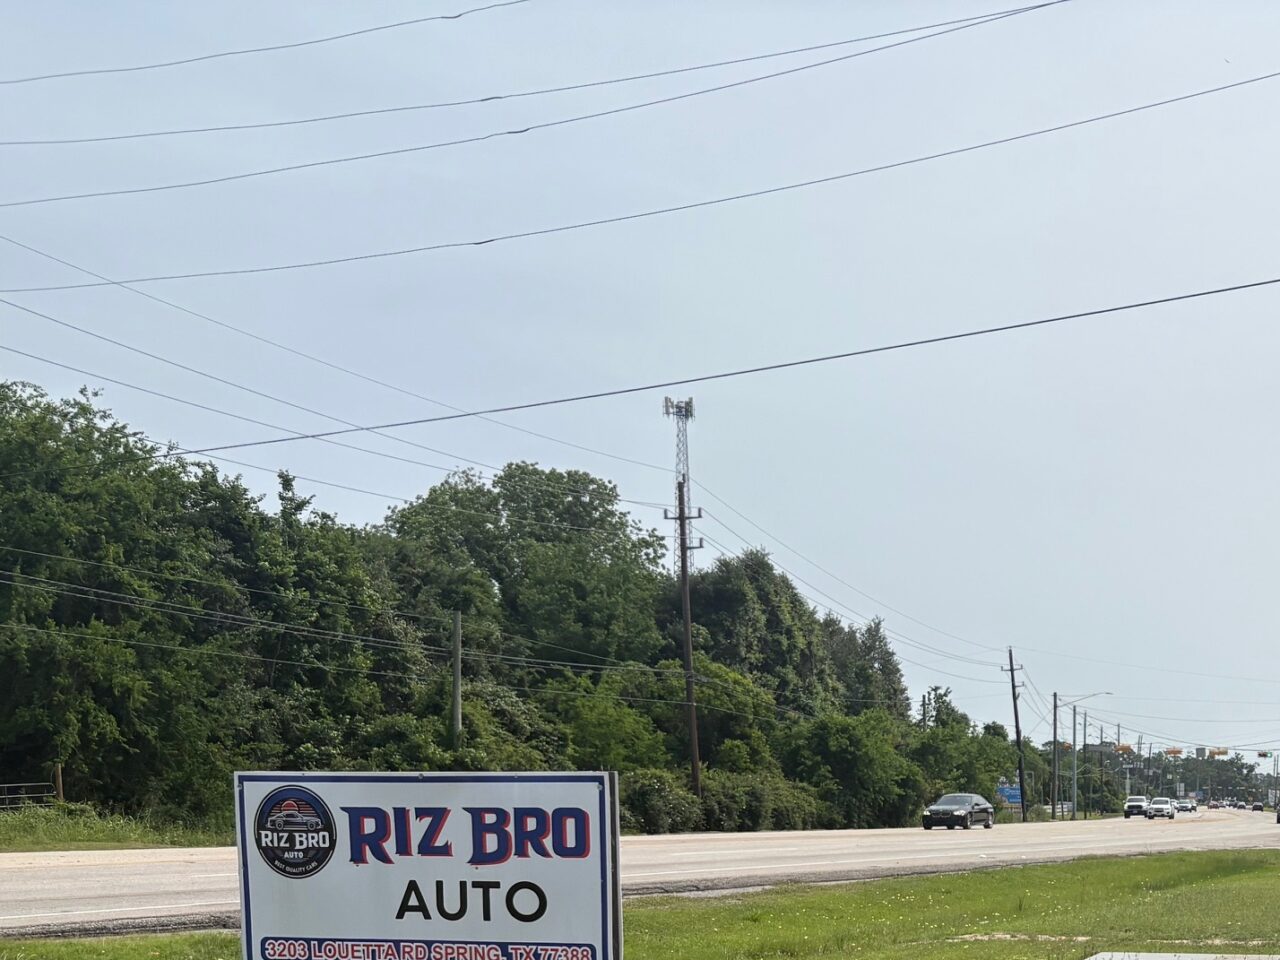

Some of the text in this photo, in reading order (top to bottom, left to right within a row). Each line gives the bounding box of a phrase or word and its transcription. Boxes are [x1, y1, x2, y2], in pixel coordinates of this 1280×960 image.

[259, 830, 330, 850] RIZ BRO
[339, 806, 591, 866] RIZ BRO
[284, 851, 304, 859] AUTO
[306, 861, 318, 870] CARS
[395, 880, 548, 923] AUTO
[265, 940, 308, 959] 3203
[311, 941, 399, 960] LOUETTA
